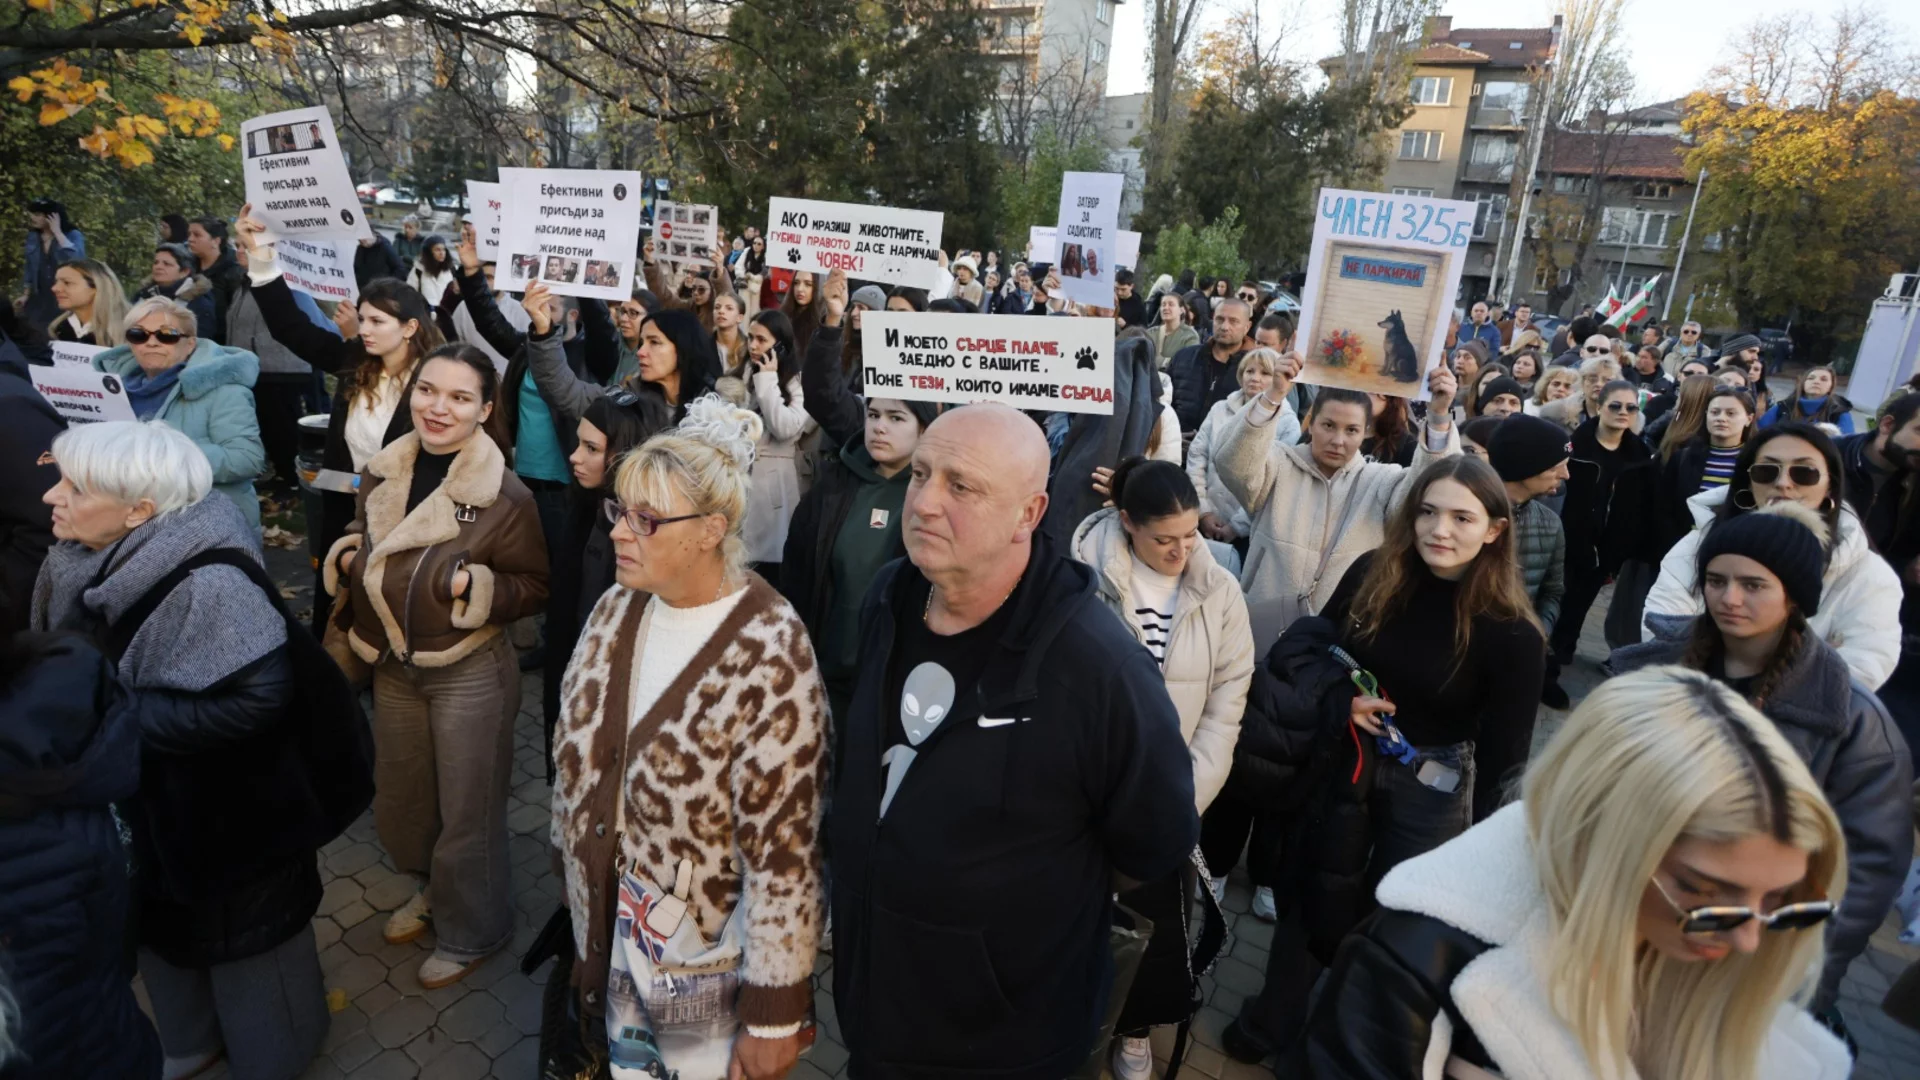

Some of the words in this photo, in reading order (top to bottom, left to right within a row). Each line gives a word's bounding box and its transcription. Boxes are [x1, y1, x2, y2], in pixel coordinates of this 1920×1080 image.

[259, 156, 310, 173] Ефективни
[263, 177, 304, 193] присъди
[305, 176, 318, 187] за
[540, 183, 603, 198] Ефективни
[265, 199, 308, 211] насилие
[309, 196, 331, 209] над
[1077, 196, 1100, 209] ЗАТВОР
[540, 205, 589, 219] присъди
[591, 207, 604, 218] за
[1081, 211, 1090, 222] ЗА
[1322, 195, 1394, 239] ЧЛЕН
[282, 217, 329, 229] животни
[780, 211, 808, 229] АКО
[812, 220, 850, 234] МРАЗИШ
[858, 223, 930, 245] ЖИВОТНИТЕ,
[535, 224, 582, 237] насилие
[584, 228, 606, 241] над
[1067, 224, 1102, 240] САДИСТИТЕ
[289, 240, 317, 255] могат
[322, 248, 336, 258] да
[539, 244, 593, 257] животни
[770, 231, 801, 245] ГУБИШ
[807, 236, 850, 250] ПРАВОТО
[855, 241, 871, 253] ДА
[872, 243, 885, 255] СЕ
[889, 245, 939, 261] НАРИЧАШ
[278, 252, 317, 275] говорят,
[319, 266, 326, 275] а
[328, 267, 345, 278] ти
[816, 251, 864, 272] ЧОВЕК!
[1346, 262, 1359, 273] НЕ
[1363, 263, 1421, 281] ПАРКИРАЙ
[885, 328, 899, 348] И
[904, 335, 948, 350] МОЕТО
[956, 337, 1007, 354] СЪРЦЕ
[1011, 340, 1065, 359] ПЛАЧЕ,
[899, 351, 955, 369] ЗАЕДНО
[962, 355, 972, 368] С
[37, 383, 104, 400] Хуманността
[909, 375, 951, 393] ТЕЗИ,
[955, 378, 1002, 394] КОИТО
[1009, 383, 1059, 398] ИМАМЕ
[1061, 385, 1113, 404] СЪРЦА
[52, 400, 93, 413] започва
